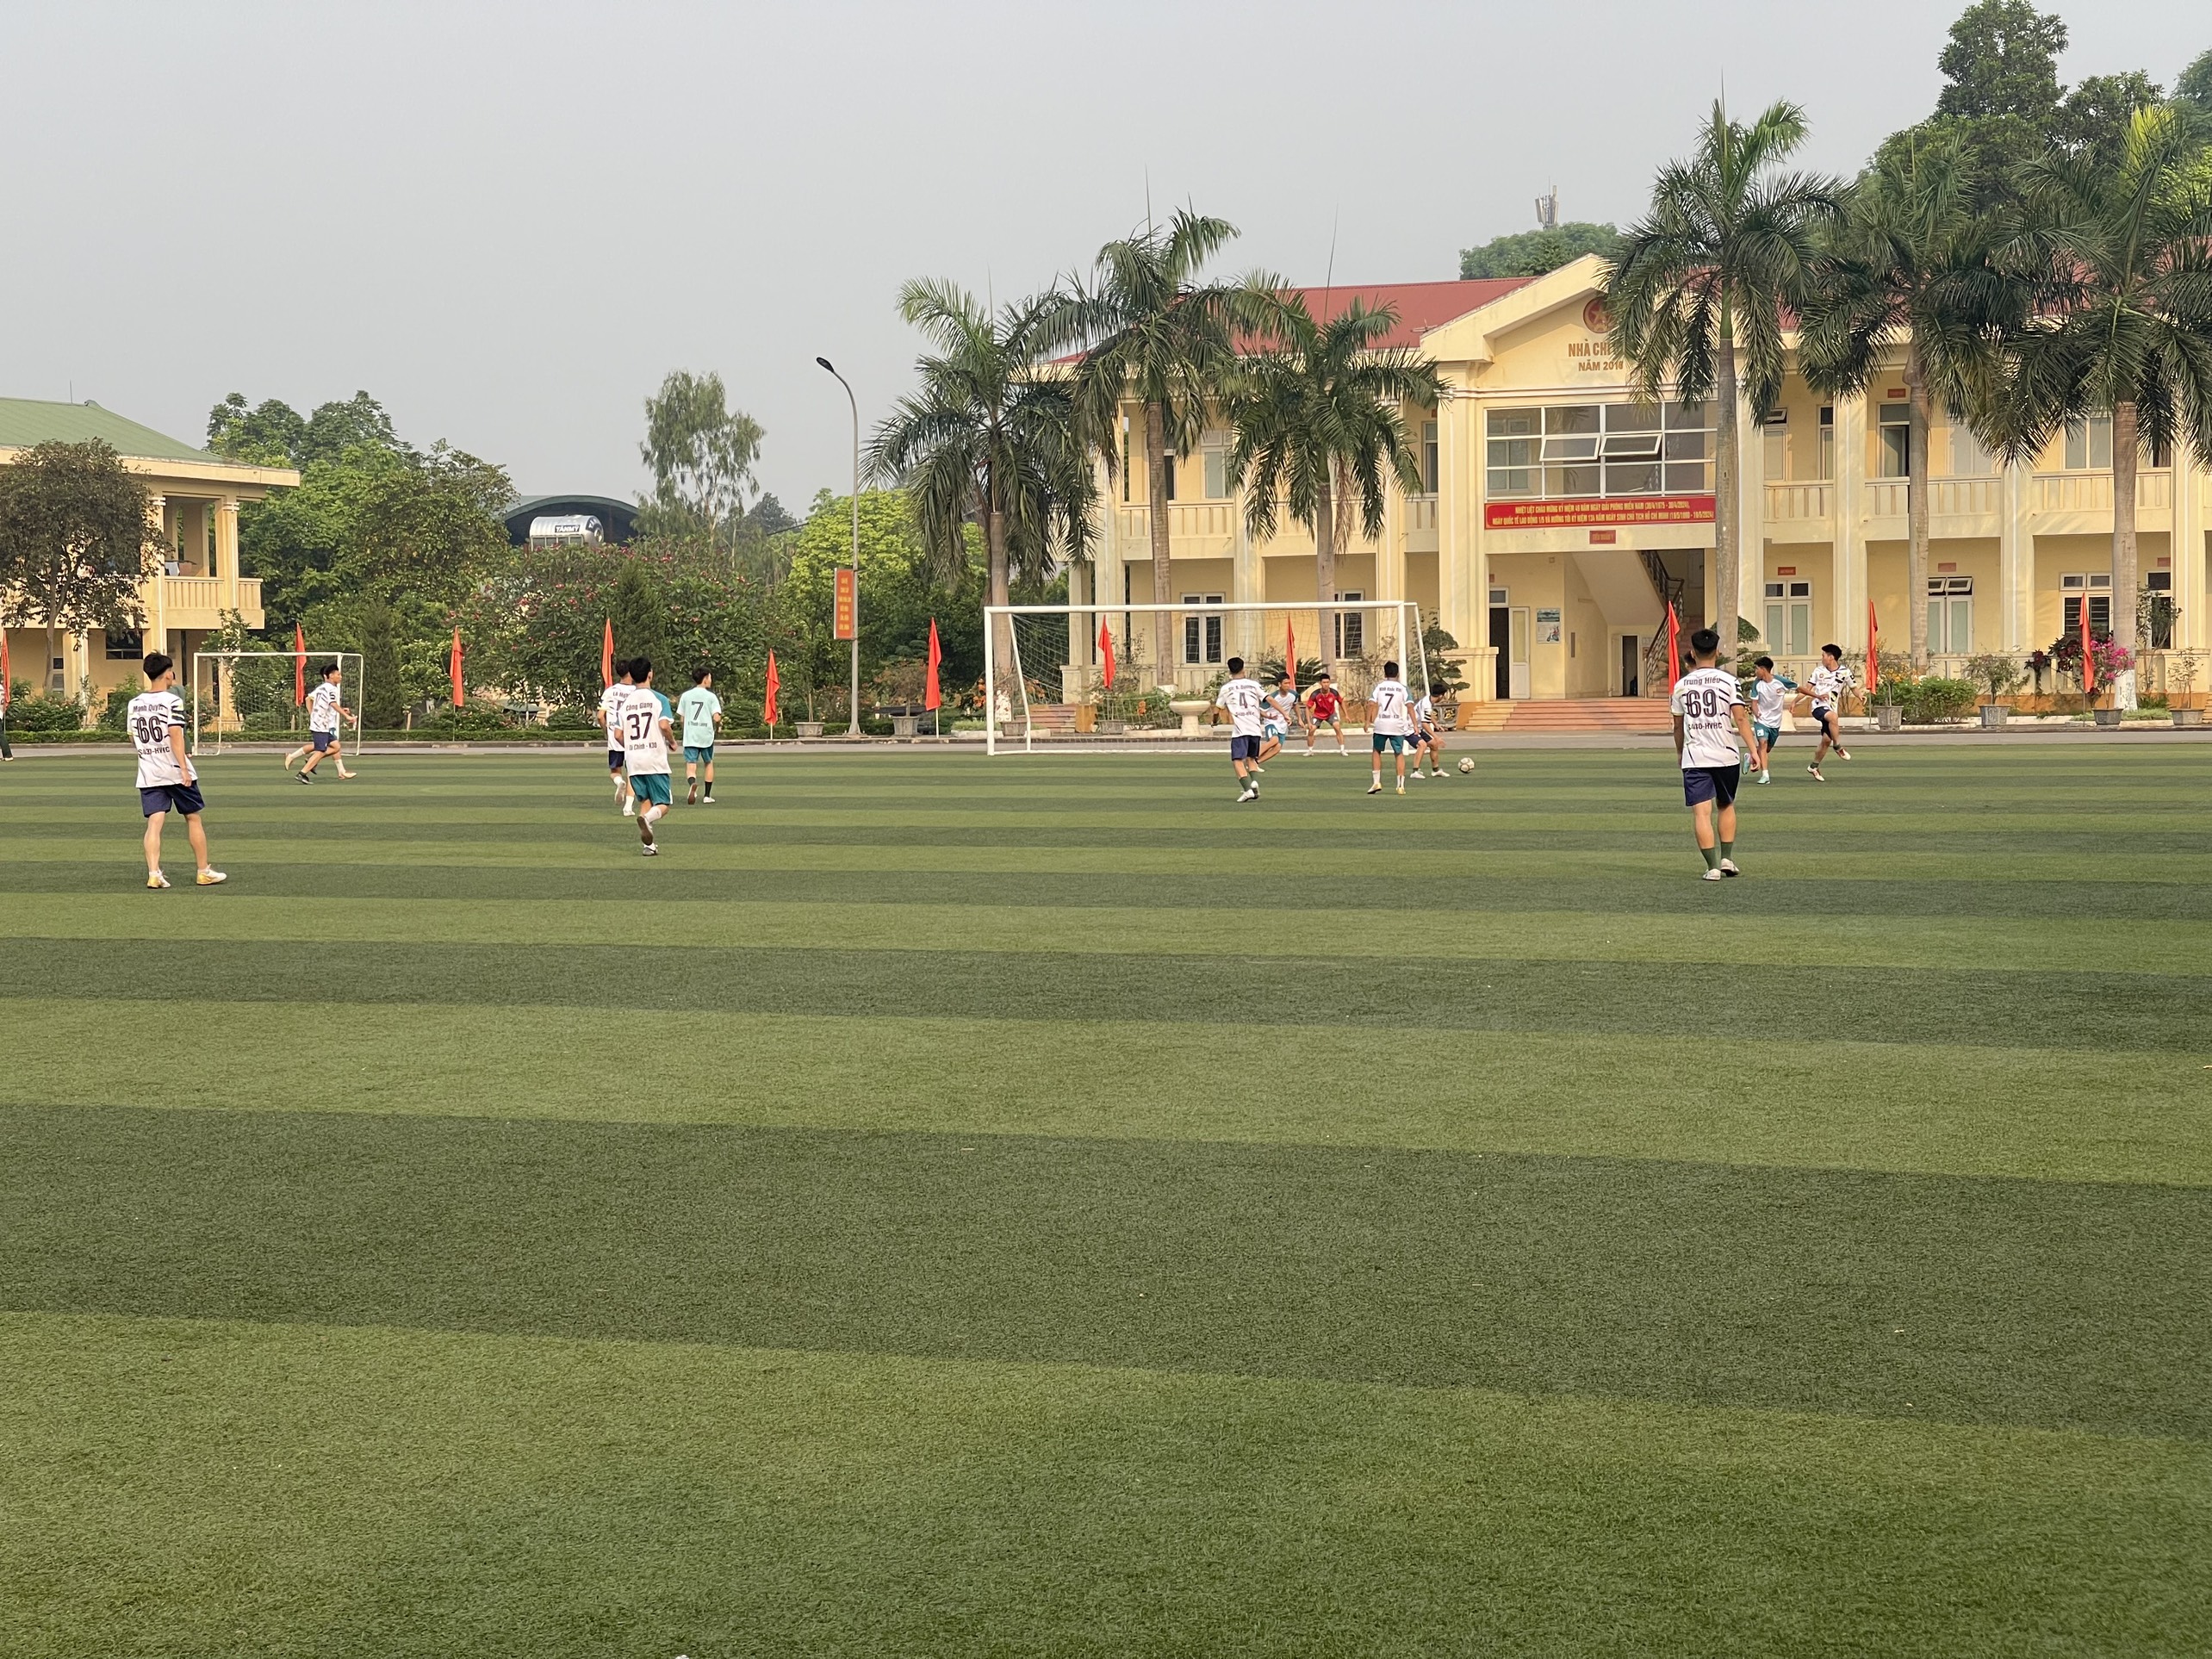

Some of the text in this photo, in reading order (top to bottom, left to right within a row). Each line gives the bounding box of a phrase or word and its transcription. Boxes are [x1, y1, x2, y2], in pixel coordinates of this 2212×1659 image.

[1568, 339, 1591, 357] NHÀ
[1578, 359, 1600, 371] NĂM
[1240, 693, 1247, 708] 4
[1385, 693, 1394, 711] 7
[1687, 689, 1718, 718] 69
[692, 701, 704, 720] 7
[137, 716, 163, 743] 66
[627, 712, 653, 740] 37
